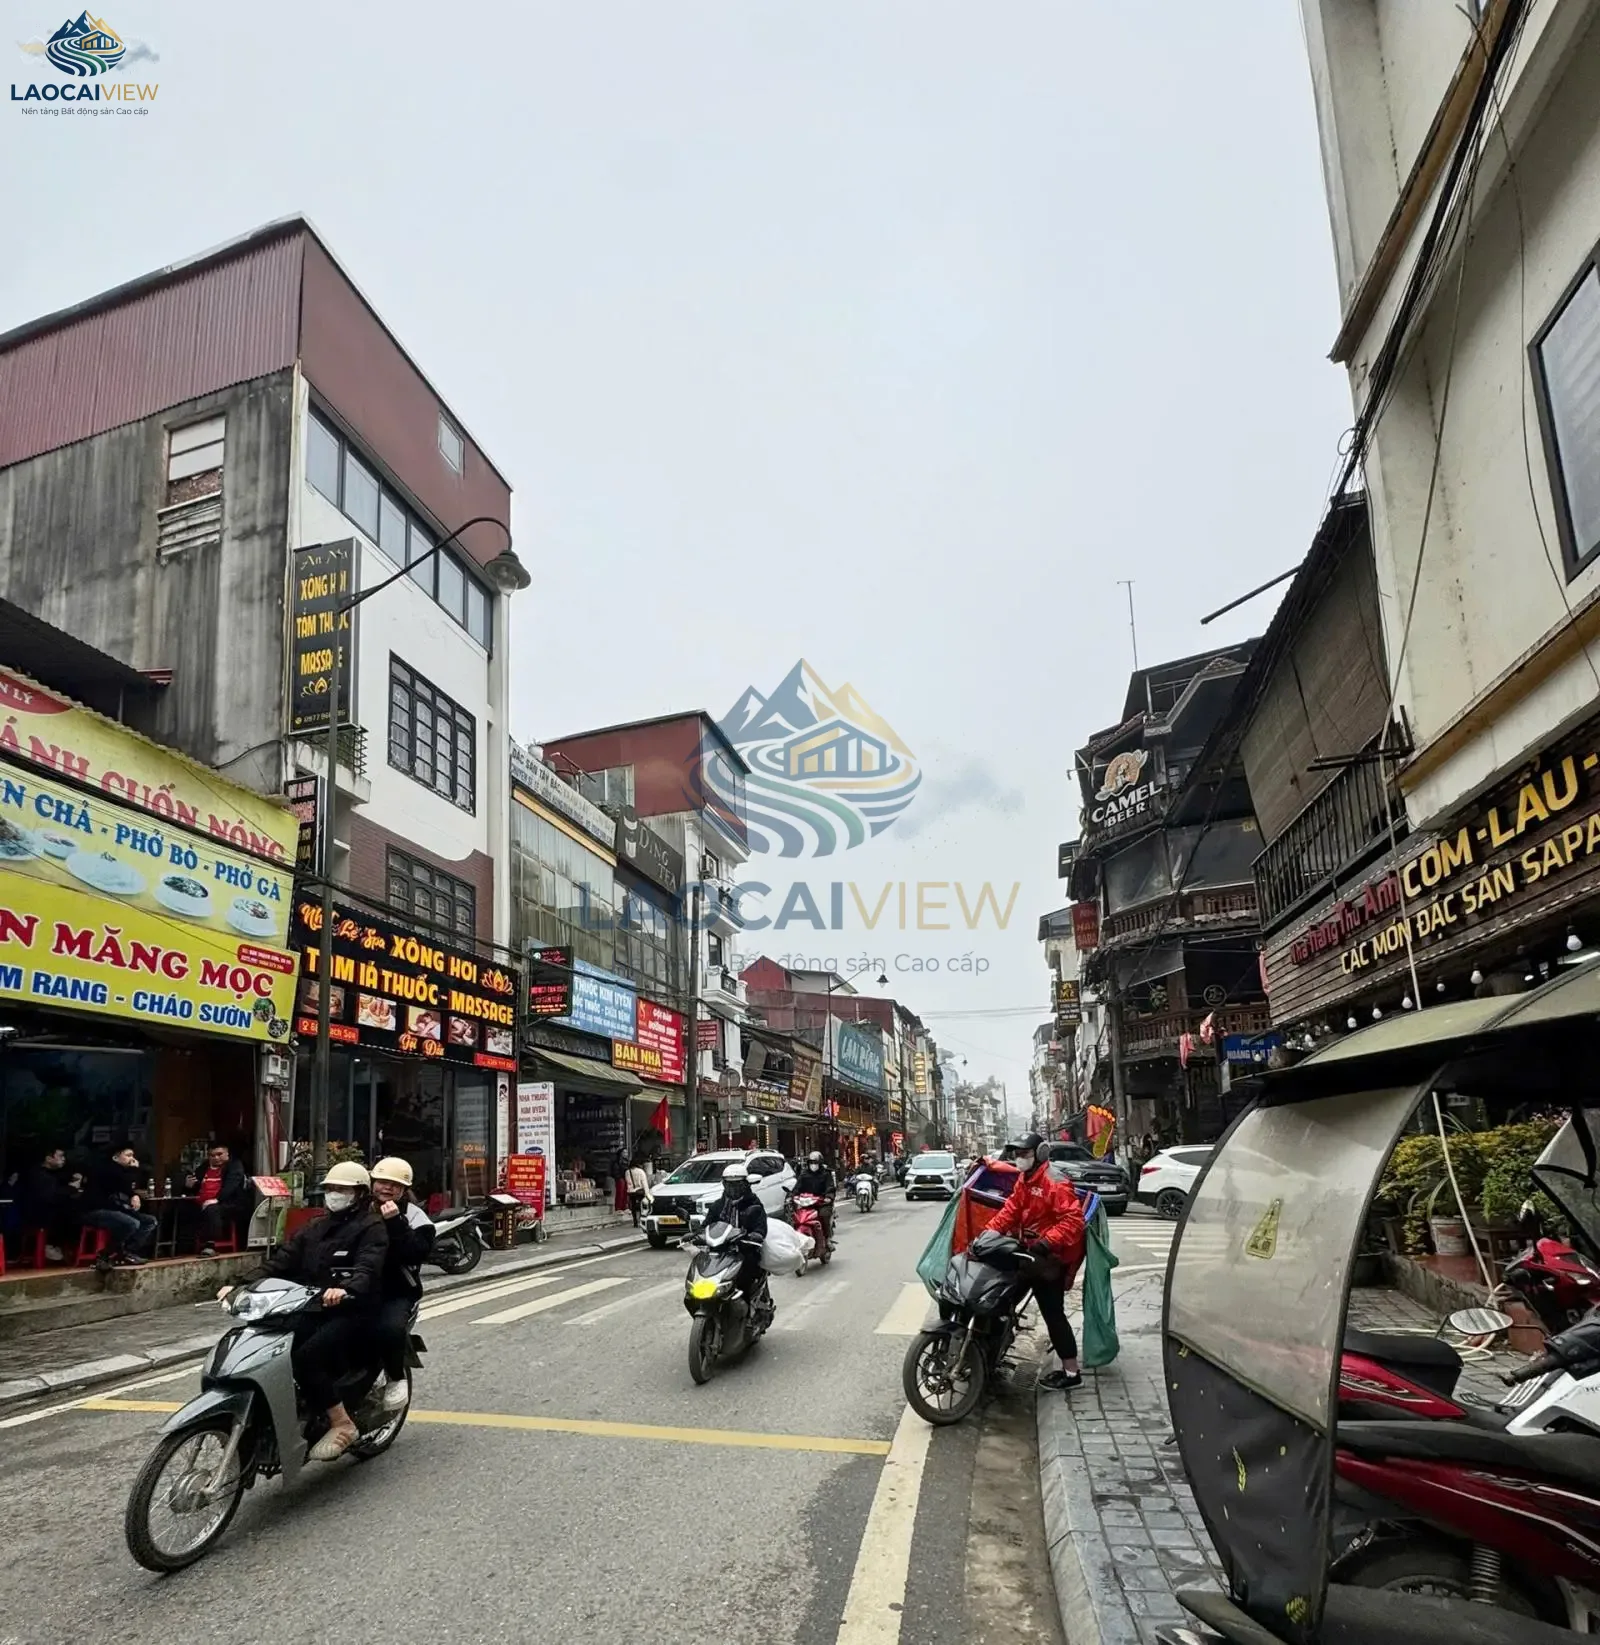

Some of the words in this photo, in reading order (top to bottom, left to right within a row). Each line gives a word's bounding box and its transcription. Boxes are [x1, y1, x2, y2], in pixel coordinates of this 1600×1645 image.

[300, 571, 328, 601] XÔNG
[300, 646, 343, 676] MASSAE
[1091, 781, 1162, 823] CAMEL
[1104, 802, 1146, 828] BEER
[115, 822, 164, 858] PHỞ
[169, 843, 198, 870] BÒ
[215, 862, 252, 890] PHỞ
[257, 875, 281, 901] GÀ
[1340, 939, 1370, 976] CÁC
[1372, 916, 1412, 960] MÓN
[1416, 894, 1458, 940] ĐẶC
[1461, 863, 1514, 915] SẢN
[52, 922, 189, 979] MĂNG
[200, 958, 275, 999] MỌC
[363, 928, 386, 950] Spa
[390, 934, 444, 973] XÔNG
[32, 971, 108, 1005] RANG
[133, 989, 193, 1019] CHÁO
[200, 1002, 251, 1029] SƯỜN
[381, 969, 438, 1006] THUỐC
[450, 989, 514, 1026] MASSAGE
[615, 1042, 638, 1062] BÁN
[640, 1049, 661, 1068] NHÀ
